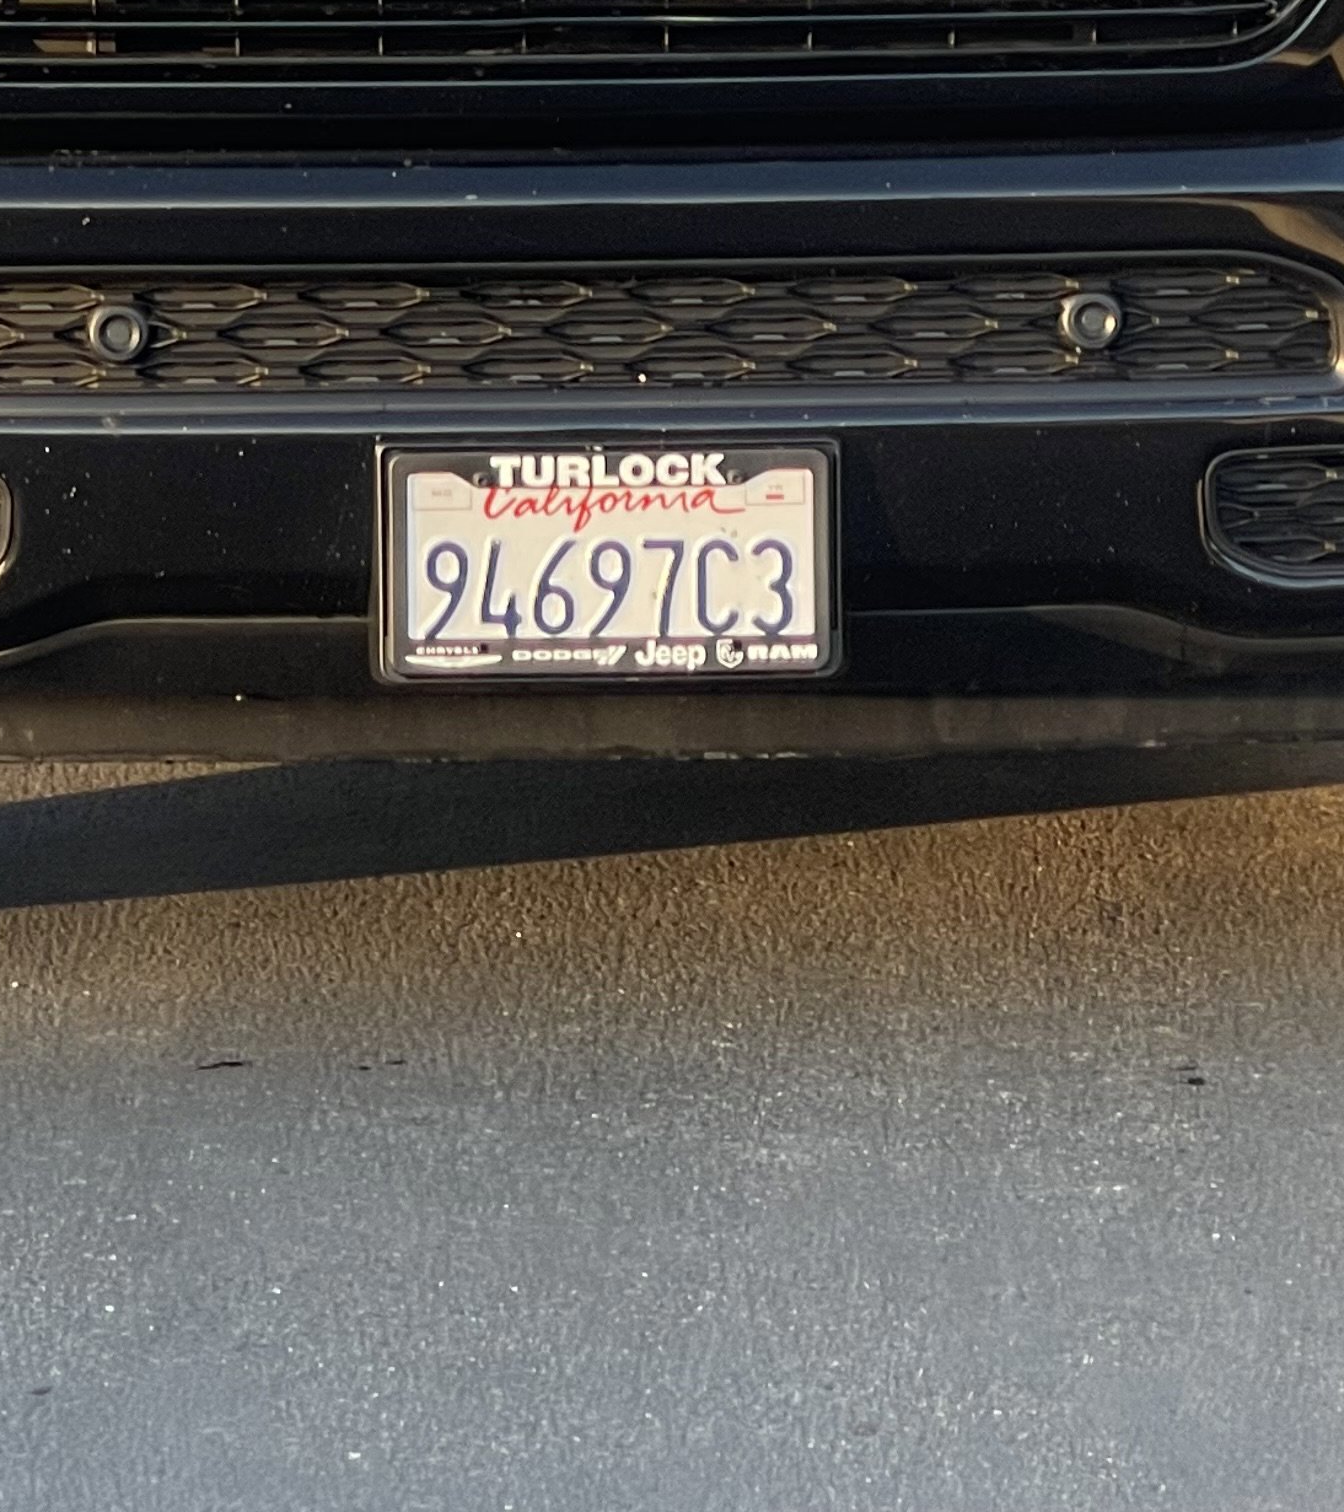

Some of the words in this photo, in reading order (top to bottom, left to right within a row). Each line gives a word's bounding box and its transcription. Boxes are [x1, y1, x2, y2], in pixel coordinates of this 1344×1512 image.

[489, 453, 727, 487] TURLOCK
[483, 487, 747, 533] California
[425, 539, 794, 639] 94697C3
[635, 639, 707, 671] Jeep
[748, 644, 818, 660] RAM
